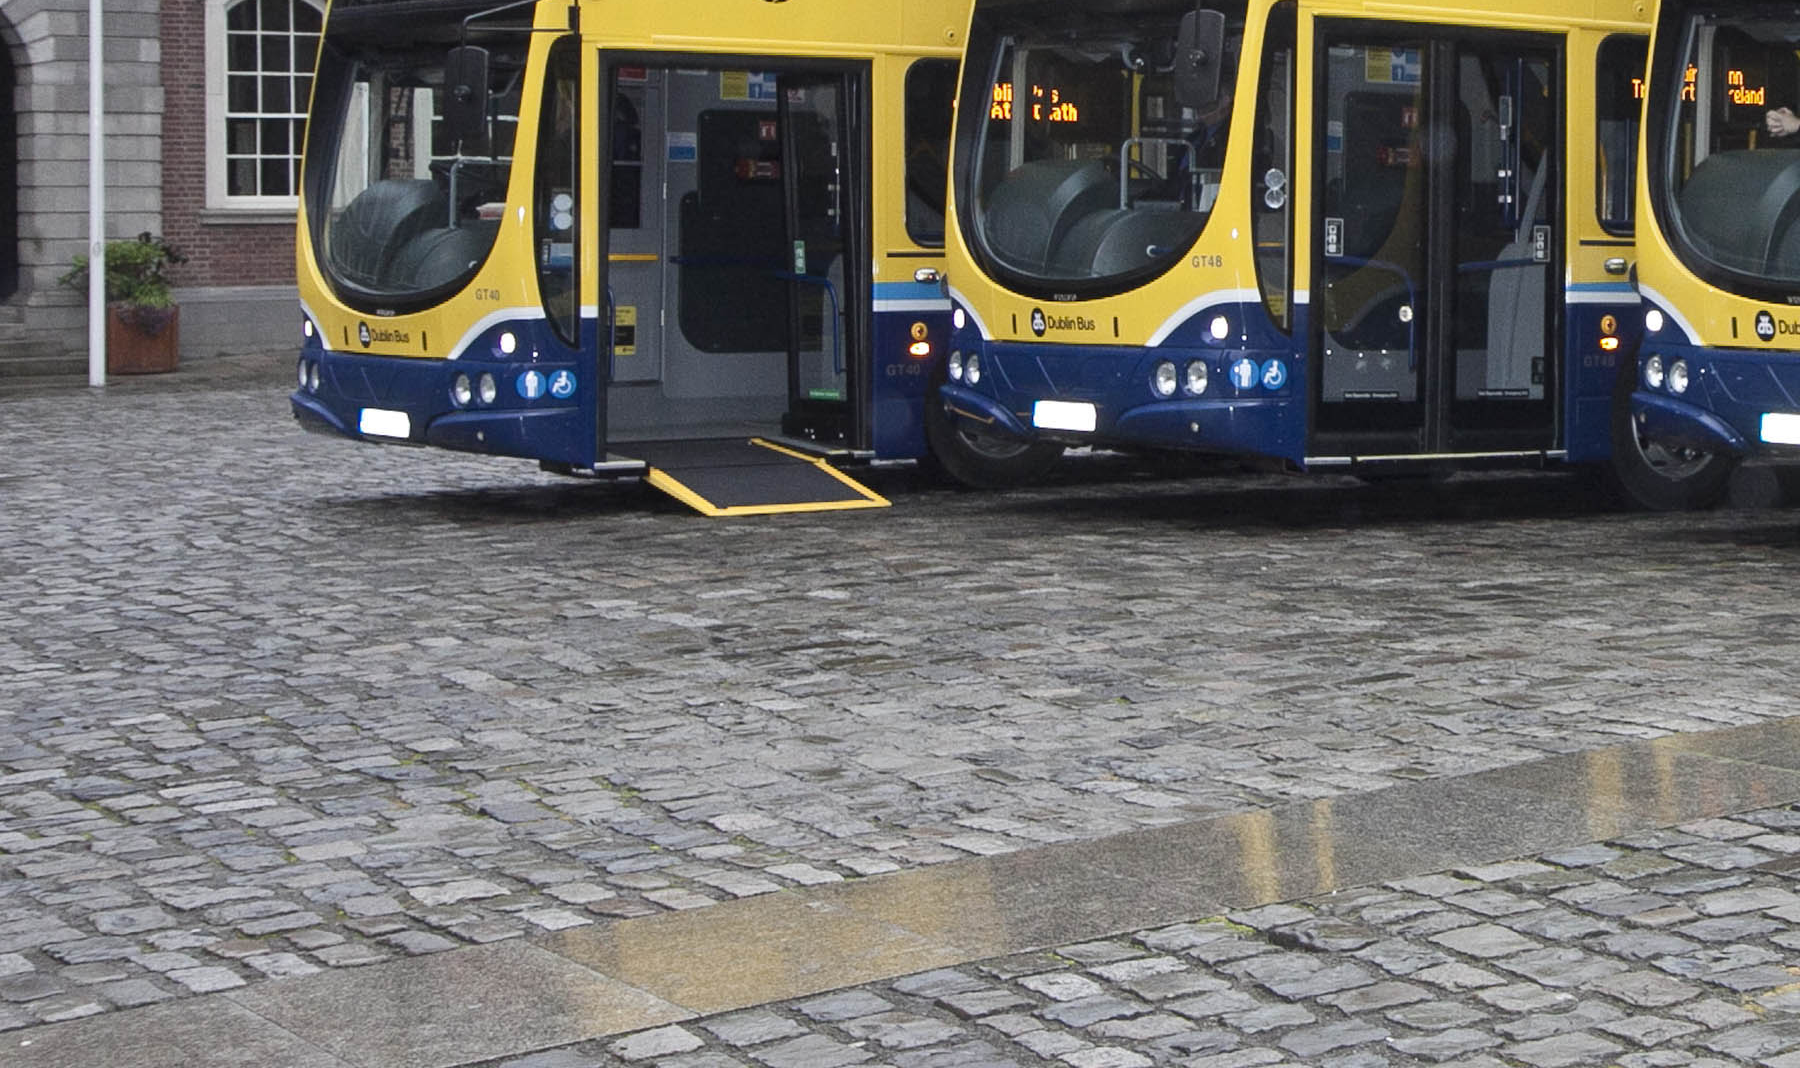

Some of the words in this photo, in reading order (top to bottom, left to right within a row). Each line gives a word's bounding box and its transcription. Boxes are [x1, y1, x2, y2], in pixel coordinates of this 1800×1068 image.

[475, 288, 500, 301] GT40
[1048, 315, 1076, 331] Dublin
[1077, 317, 1096, 331] Bus
[372, 328, 394, 343] Dublin
[394, 330, 410, 344] Bus
